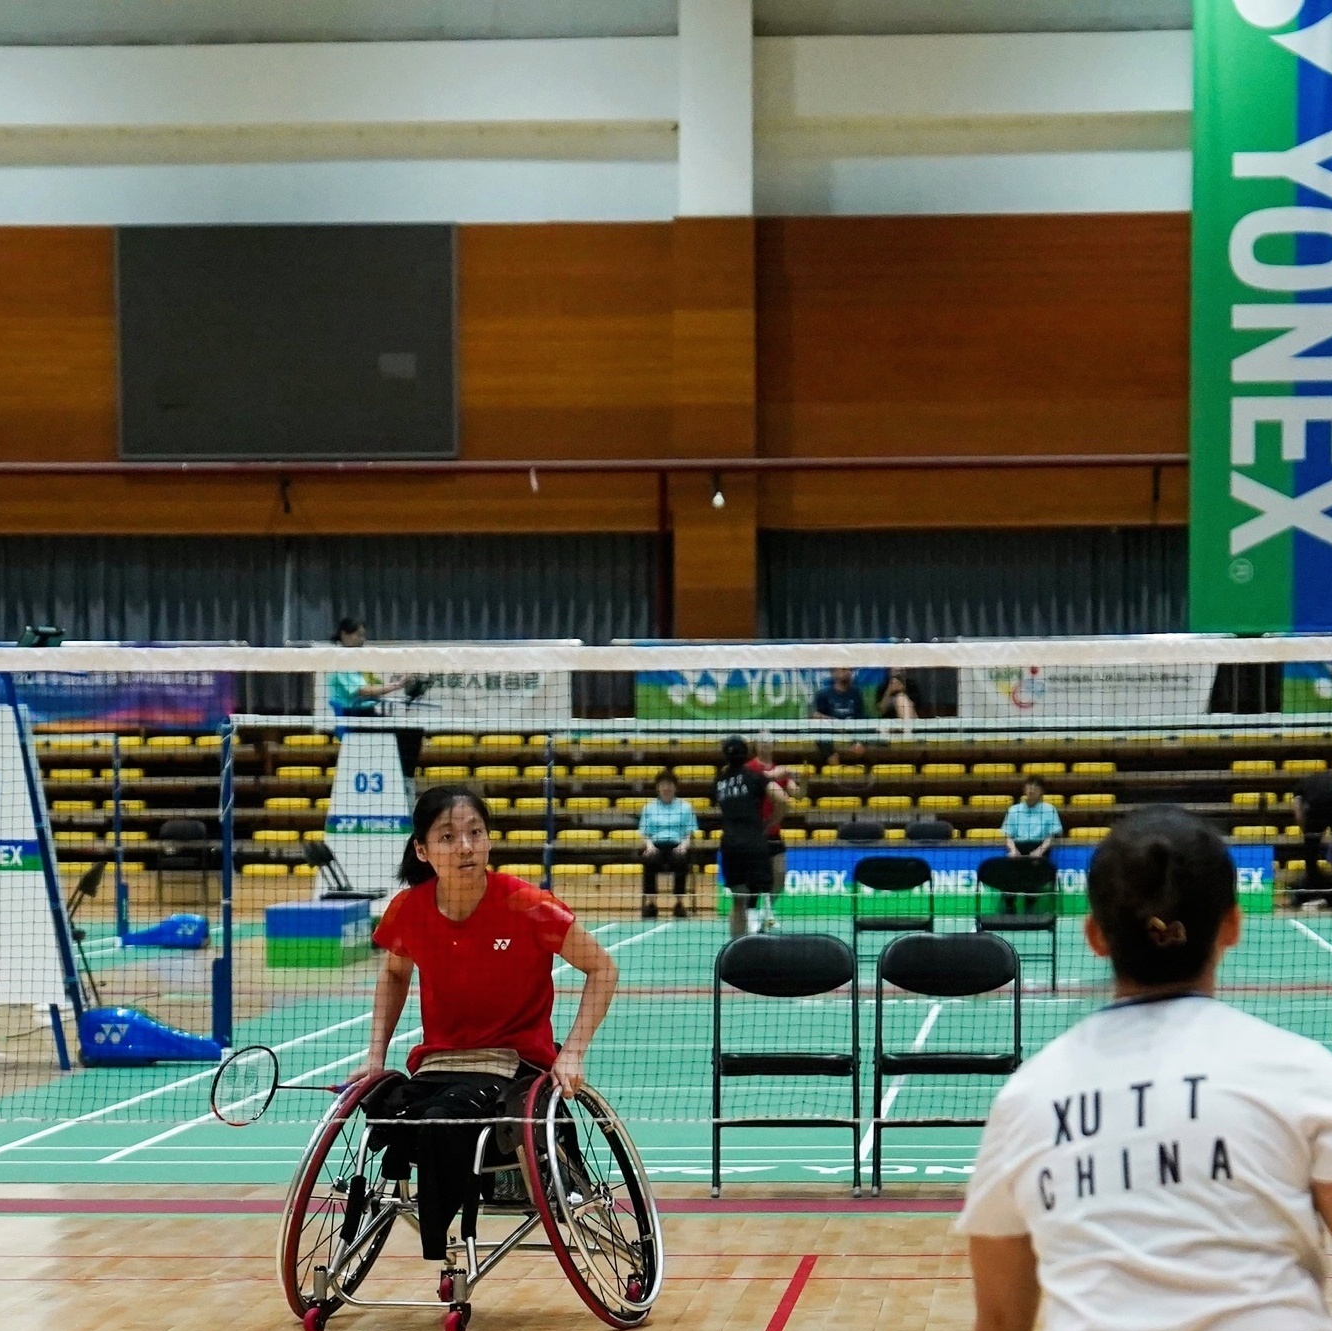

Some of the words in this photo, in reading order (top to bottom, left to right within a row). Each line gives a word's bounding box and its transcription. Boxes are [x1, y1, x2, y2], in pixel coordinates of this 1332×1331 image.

[355, 772, 383, 793] 03
[784, 869, 847, 893] ONEX
[1052, 1090, 1102, 1146] XU
[802, 1165, 976, 1175] YON
[1038, 1136, 1233, 1211] CHINA
